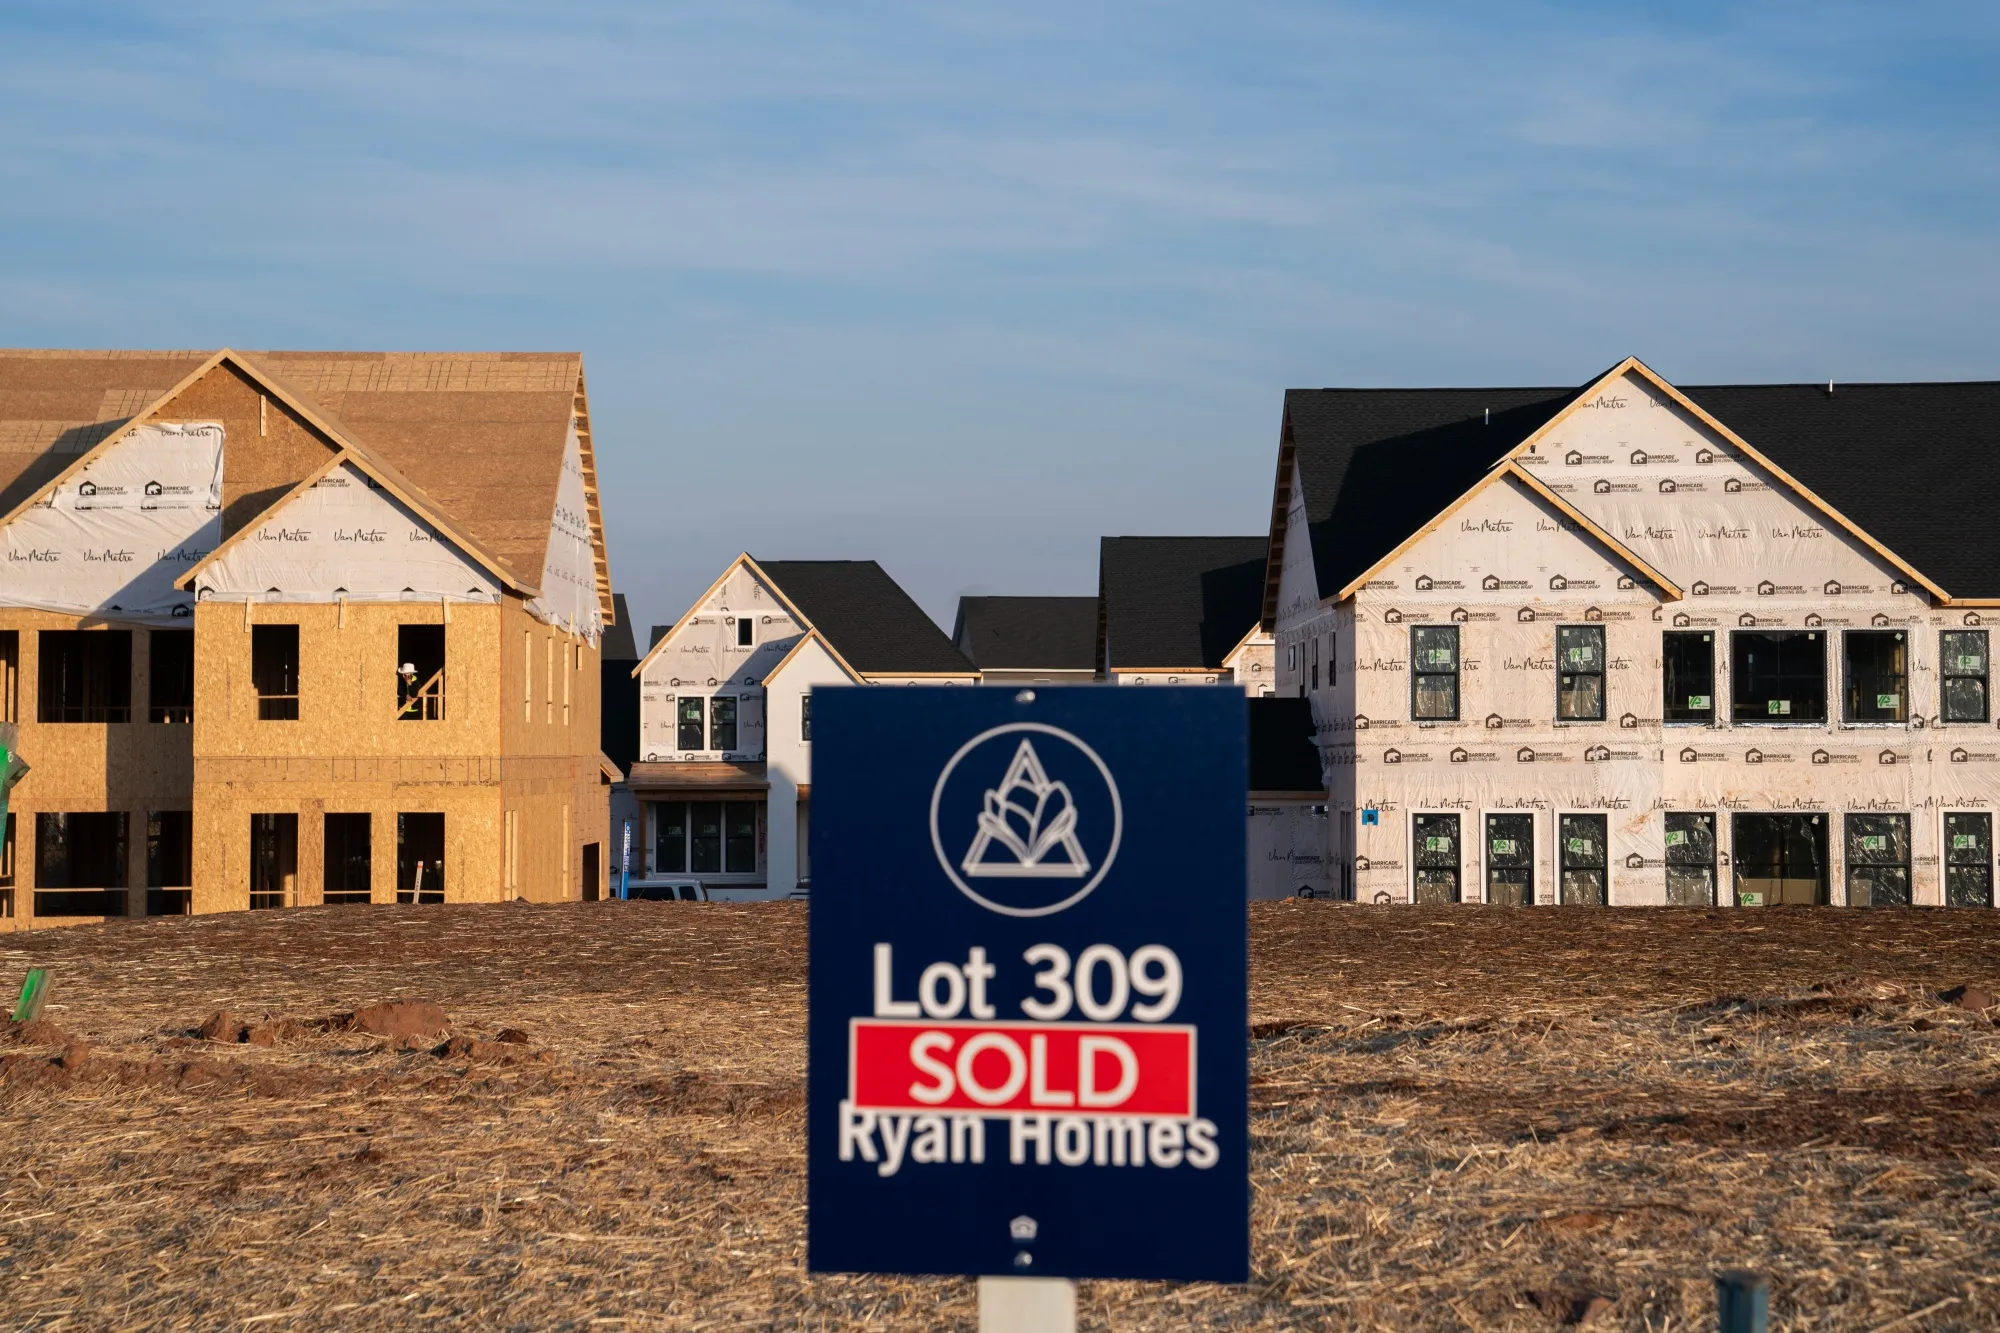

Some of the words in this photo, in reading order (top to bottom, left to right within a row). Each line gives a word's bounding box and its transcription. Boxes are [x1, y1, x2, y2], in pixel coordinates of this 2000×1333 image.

[1596, 396, 1628, 409] Metre
[1461, 518, 1480, 533] Van
[1481, 519, 1514, 532] Metre
[1536, 518, 1555, 532] Van
[258, 528, 277, 542] Van
[278, 528, 311, 542] Metre
[334, 530, 352, 542] Van
[354, 528, 387, 542] Metre
[409, 528, 428, 542] Van
[1625, 526, 1643, 540] Van
[1644, 526, 1676, 540] Metre
[1718, 526, 1750, 540] Metre
[1772, 529, 1790, 539] Van
[1792, 526, 1824, 539] Metre
[9, 549, 27, 562] Van
[29, 549, 61, 563] Metre
[84, 549, 102, 562] Van
[103, 549, 135, 562] Metre
[158, 550, 175, 562] Van
[1355, 657, 1372, 671] Van
[1374, 658, 1406, 671] Metre
[1464, 659, 1481, 670] tre
[1503, 657, 1522, 670] Van
[1524, 658, 1554, 671] Metre
[1609, 657, 1632, 670] etre
[1912, 658, 1931, 672] Van
[1570, 796, 1589, 808] Van
[1597, 796, 1630, 809] Metre
[1698, 799, 1716, 809] Van
[1718, 796, 1750, 809] Metre
[1772, 799, 1791, 809] Van
[1793, 798, 1825, 810] Metre
[1847, 799, 1866, 810] Van
[1868, 798, 1900, 810] Metre
[1935, 796, 1954, 808] Van
[1956, 796, 1988, 808] Metre
[872, 943, 996, 1019] Lot
[1021, 944, 1183, 1021] 309
[909, 1033, 1139, 1107] SOLD
[839, 1099, 985, 1176] Ryan
[1011, 1113, 1219, 1170] Homes
